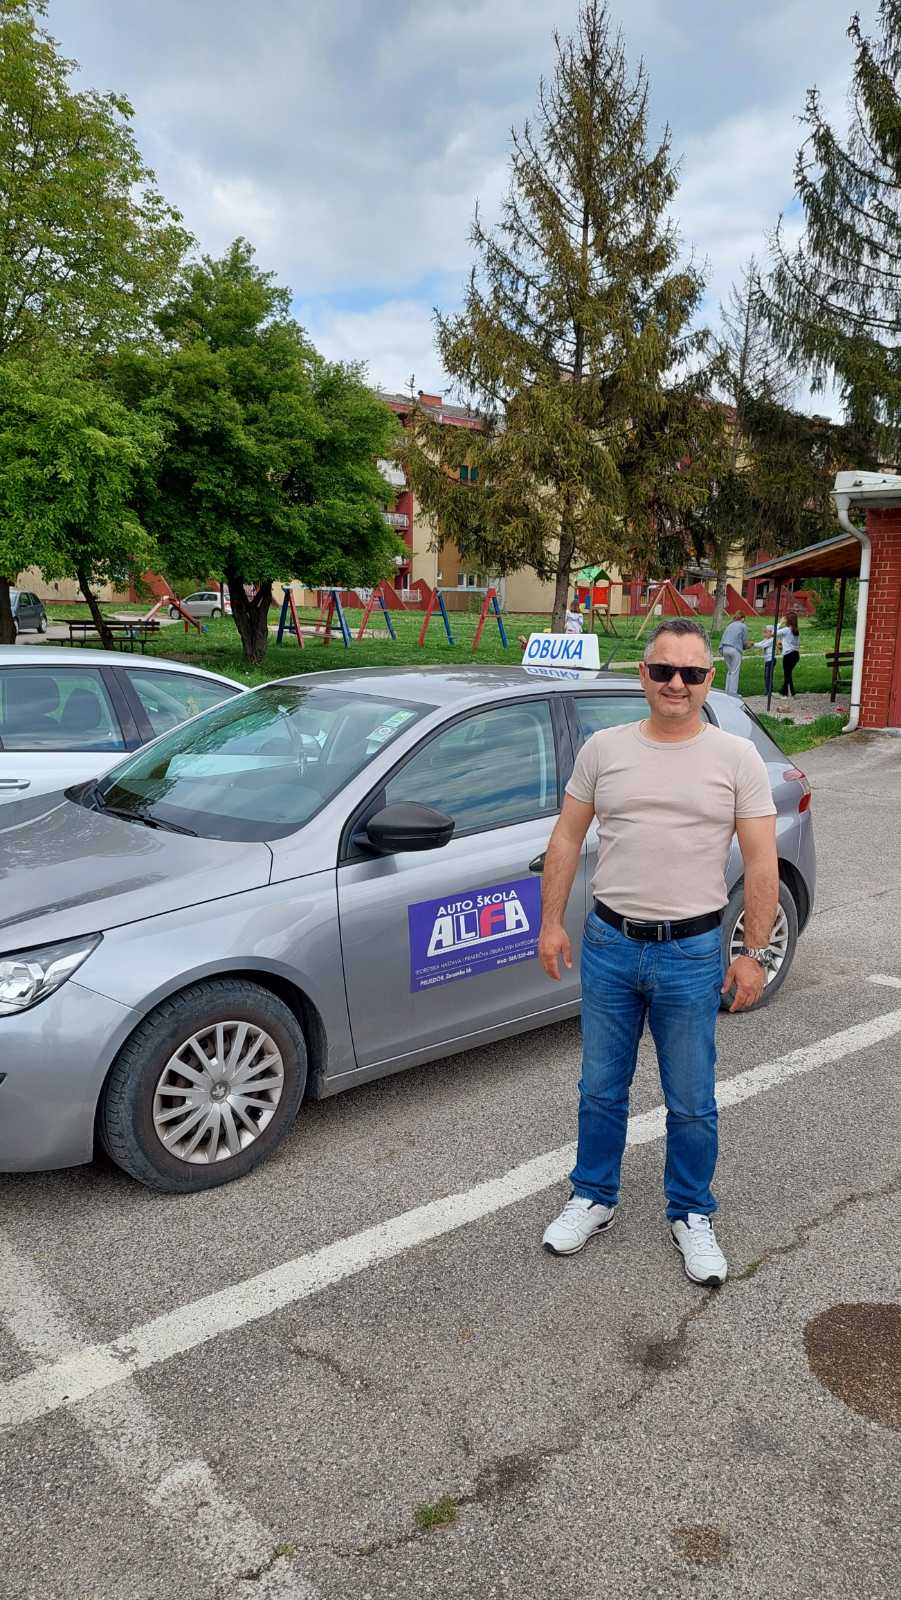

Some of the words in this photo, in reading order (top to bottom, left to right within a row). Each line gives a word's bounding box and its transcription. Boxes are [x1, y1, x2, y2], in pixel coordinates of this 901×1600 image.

[528, 638, 583, 660] OBUKA
[437, 900, 472, 917] AUTO
[477, 889, 518, 907] ŠKOLA
[427, 899, 530, 957] ALFA
